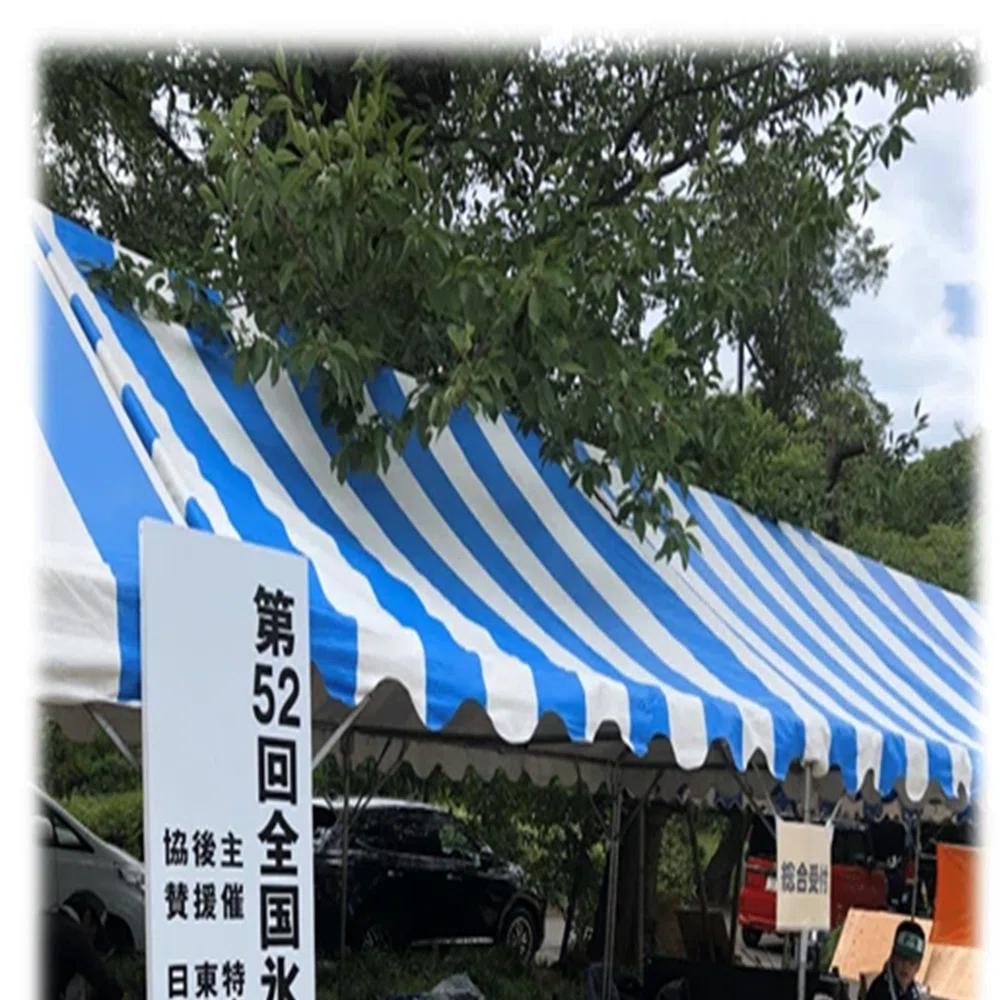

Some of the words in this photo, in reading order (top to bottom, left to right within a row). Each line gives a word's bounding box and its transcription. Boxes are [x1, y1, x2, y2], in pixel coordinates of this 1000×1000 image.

[163, 828, 189, 921] 協賛
[192, 830, 217, 920] 後援
[220, 831, 244, 920] 主催
